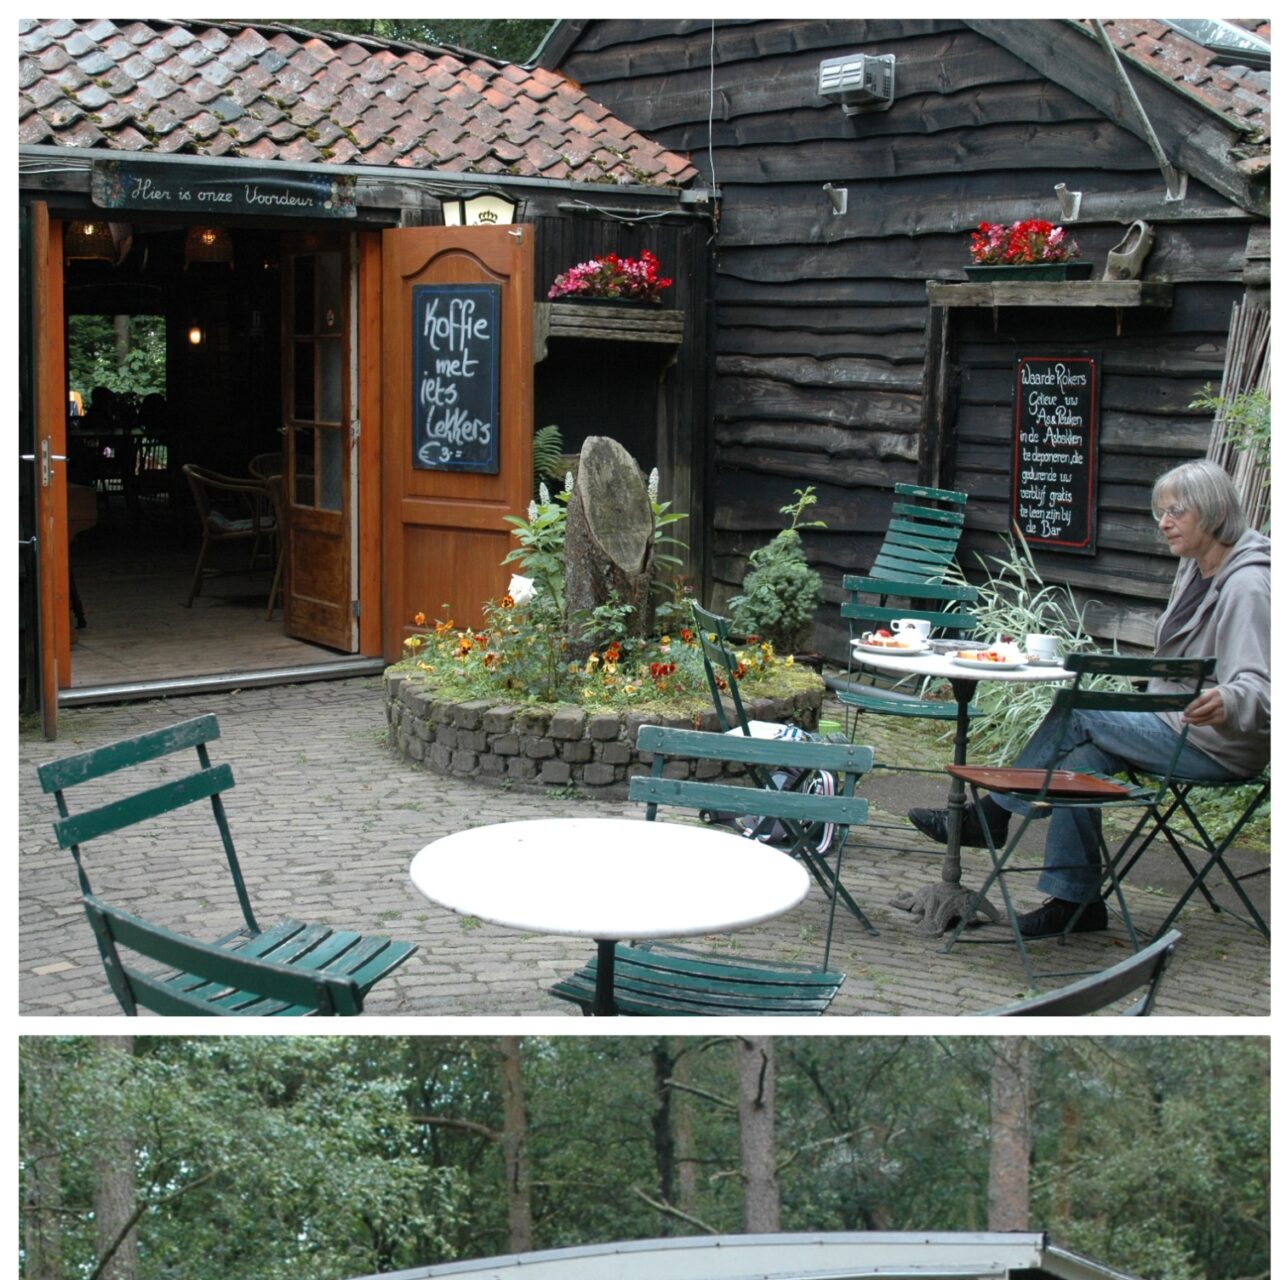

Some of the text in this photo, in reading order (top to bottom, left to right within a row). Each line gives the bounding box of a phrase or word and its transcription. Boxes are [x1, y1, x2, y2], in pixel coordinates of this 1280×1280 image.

[131, 177, 314, 207] Hier is onze Voordeur
[424, 298, 490, 351] Koffie
[436, 348, 479, 377] met
[421, 371, 457, 405] iets
[1021, 363, 1087, 395] Waarde Rokers
[1028, 391, 1079, 416] Gelieve uw
[1049, 487, 1073, 507] gratis
[1026, 519, 1062, 538] de Bar
